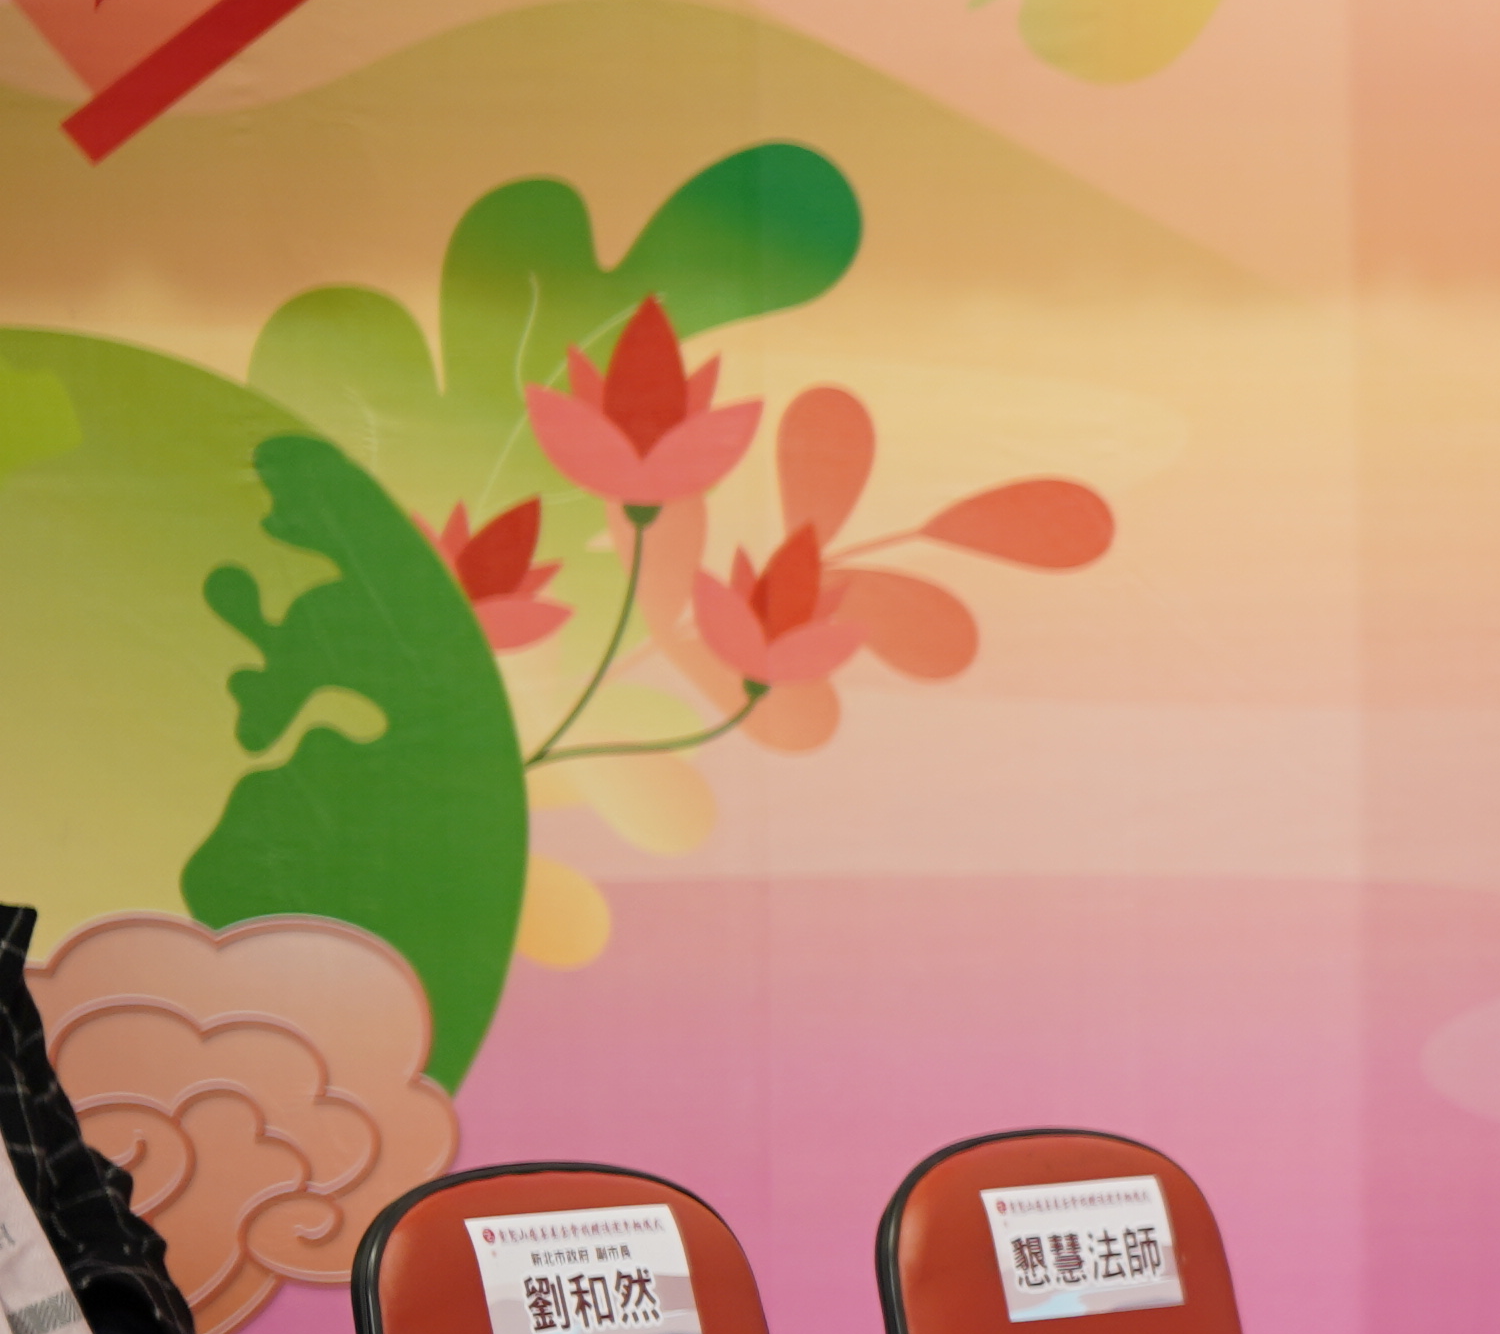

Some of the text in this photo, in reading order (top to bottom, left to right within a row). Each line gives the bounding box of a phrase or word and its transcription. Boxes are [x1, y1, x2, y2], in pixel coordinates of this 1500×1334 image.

[531, 1243, 632, 1267] 新北市政府 副市長
[1011, 1226, 1160, 1287] 懇慧法師
[524, 1268, 661, 1332] 劉和然
